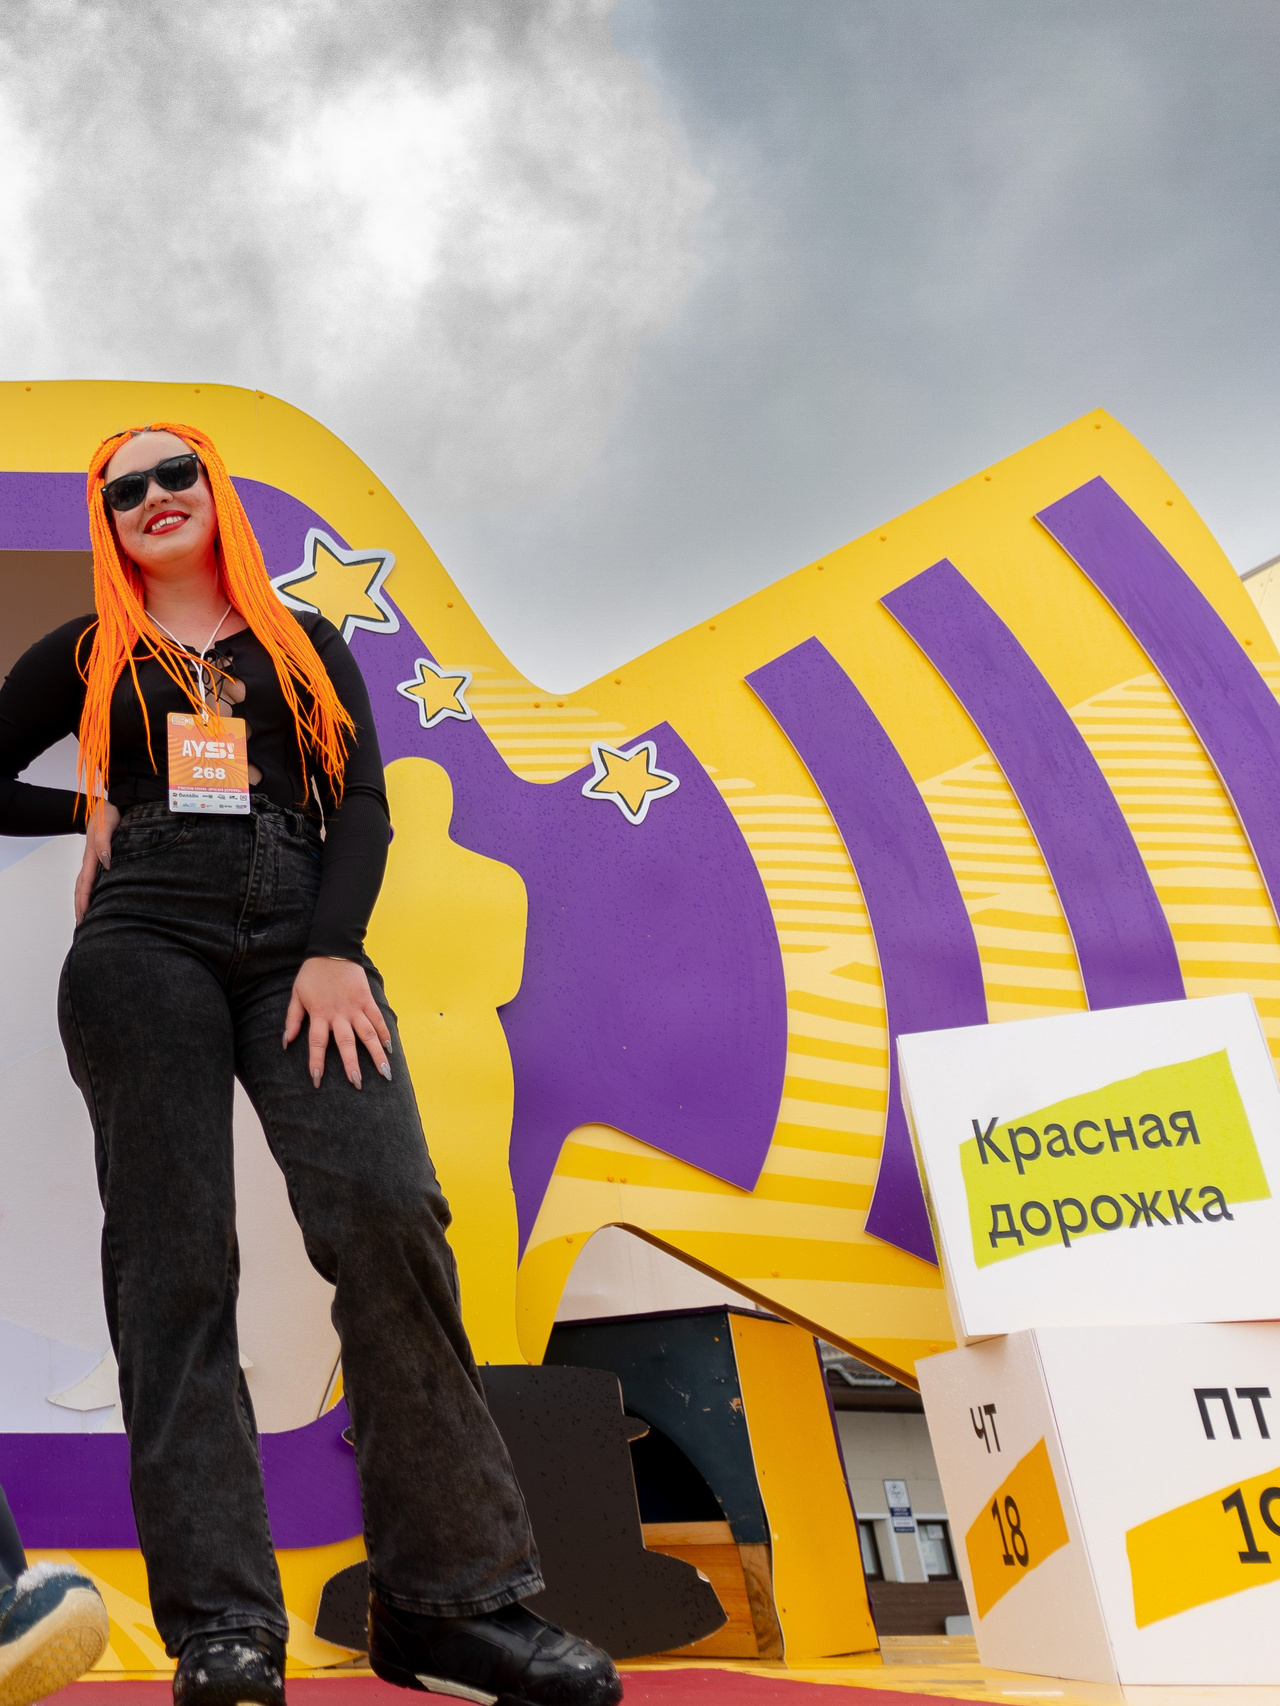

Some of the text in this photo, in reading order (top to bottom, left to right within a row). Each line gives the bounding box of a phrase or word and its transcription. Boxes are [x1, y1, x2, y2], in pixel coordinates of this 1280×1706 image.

[181, 739, 235, 760] AYS!
[192, 765, 227, 780] 268
[971, 1110, 1202, 1175] Красная
[988, 1185, 1235, 1248] дорожка
[991, 1495, 1030, 1567] 18
